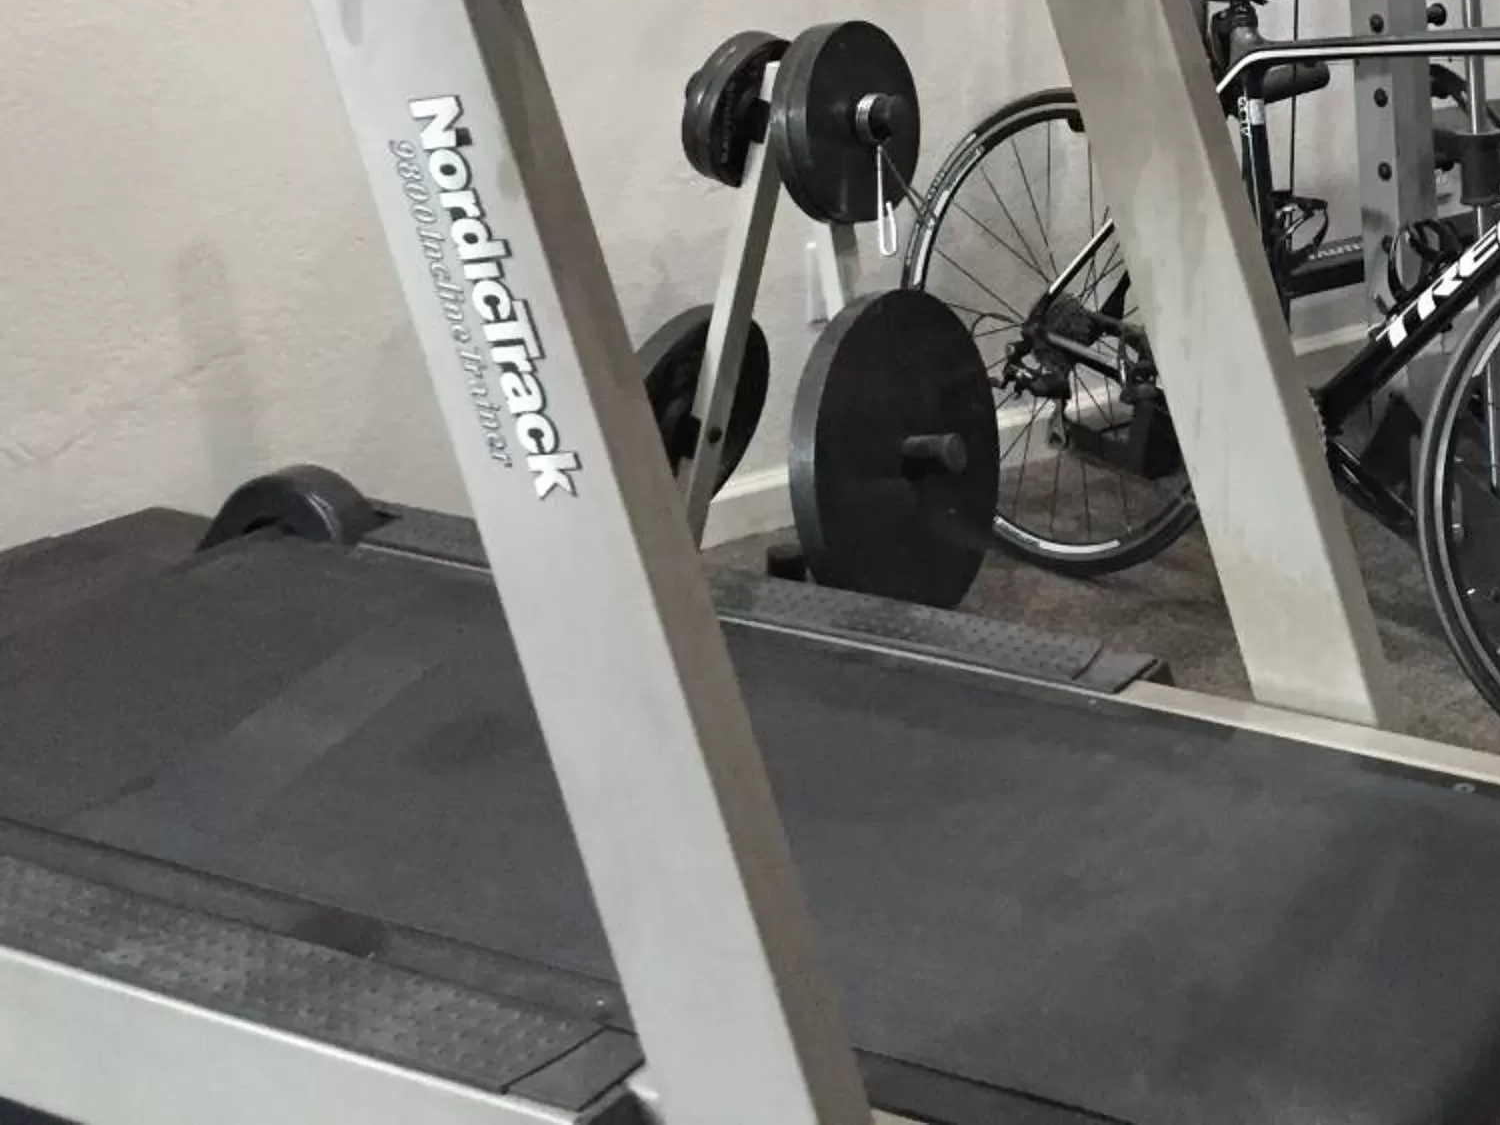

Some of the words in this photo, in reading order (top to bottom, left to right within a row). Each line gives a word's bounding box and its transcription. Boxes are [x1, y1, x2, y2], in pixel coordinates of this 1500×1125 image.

[388, 139, 437, 224] 9800
[416, 225, 472, 344] Incline
[408, 95, 582, 501] NordicTrack
